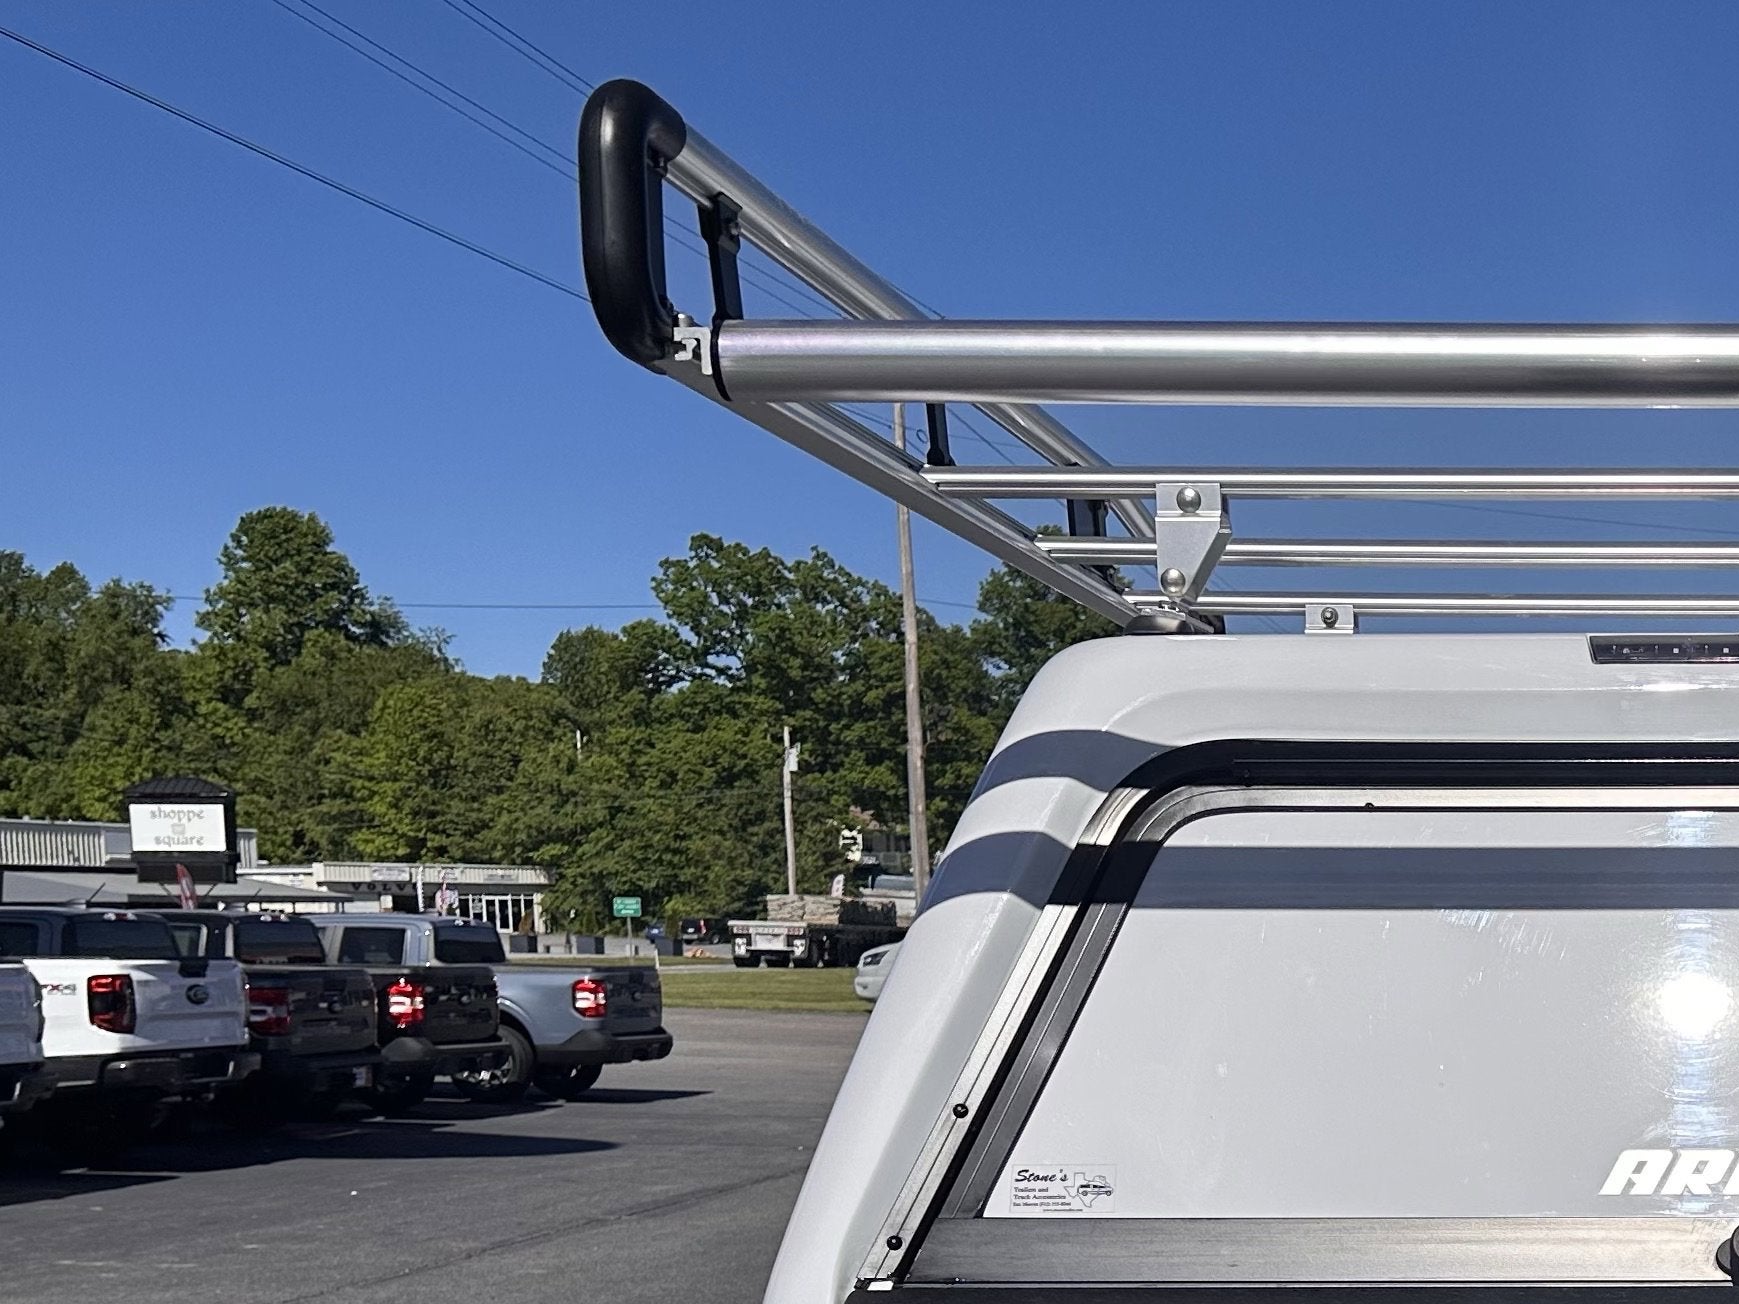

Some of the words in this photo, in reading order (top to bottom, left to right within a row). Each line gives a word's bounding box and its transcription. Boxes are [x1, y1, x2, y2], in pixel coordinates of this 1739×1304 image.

[150, 806, 205, 822] shoppe
[154, 835, 205, 848] square
[1014, 1169, 1068, 1182] Stone's
